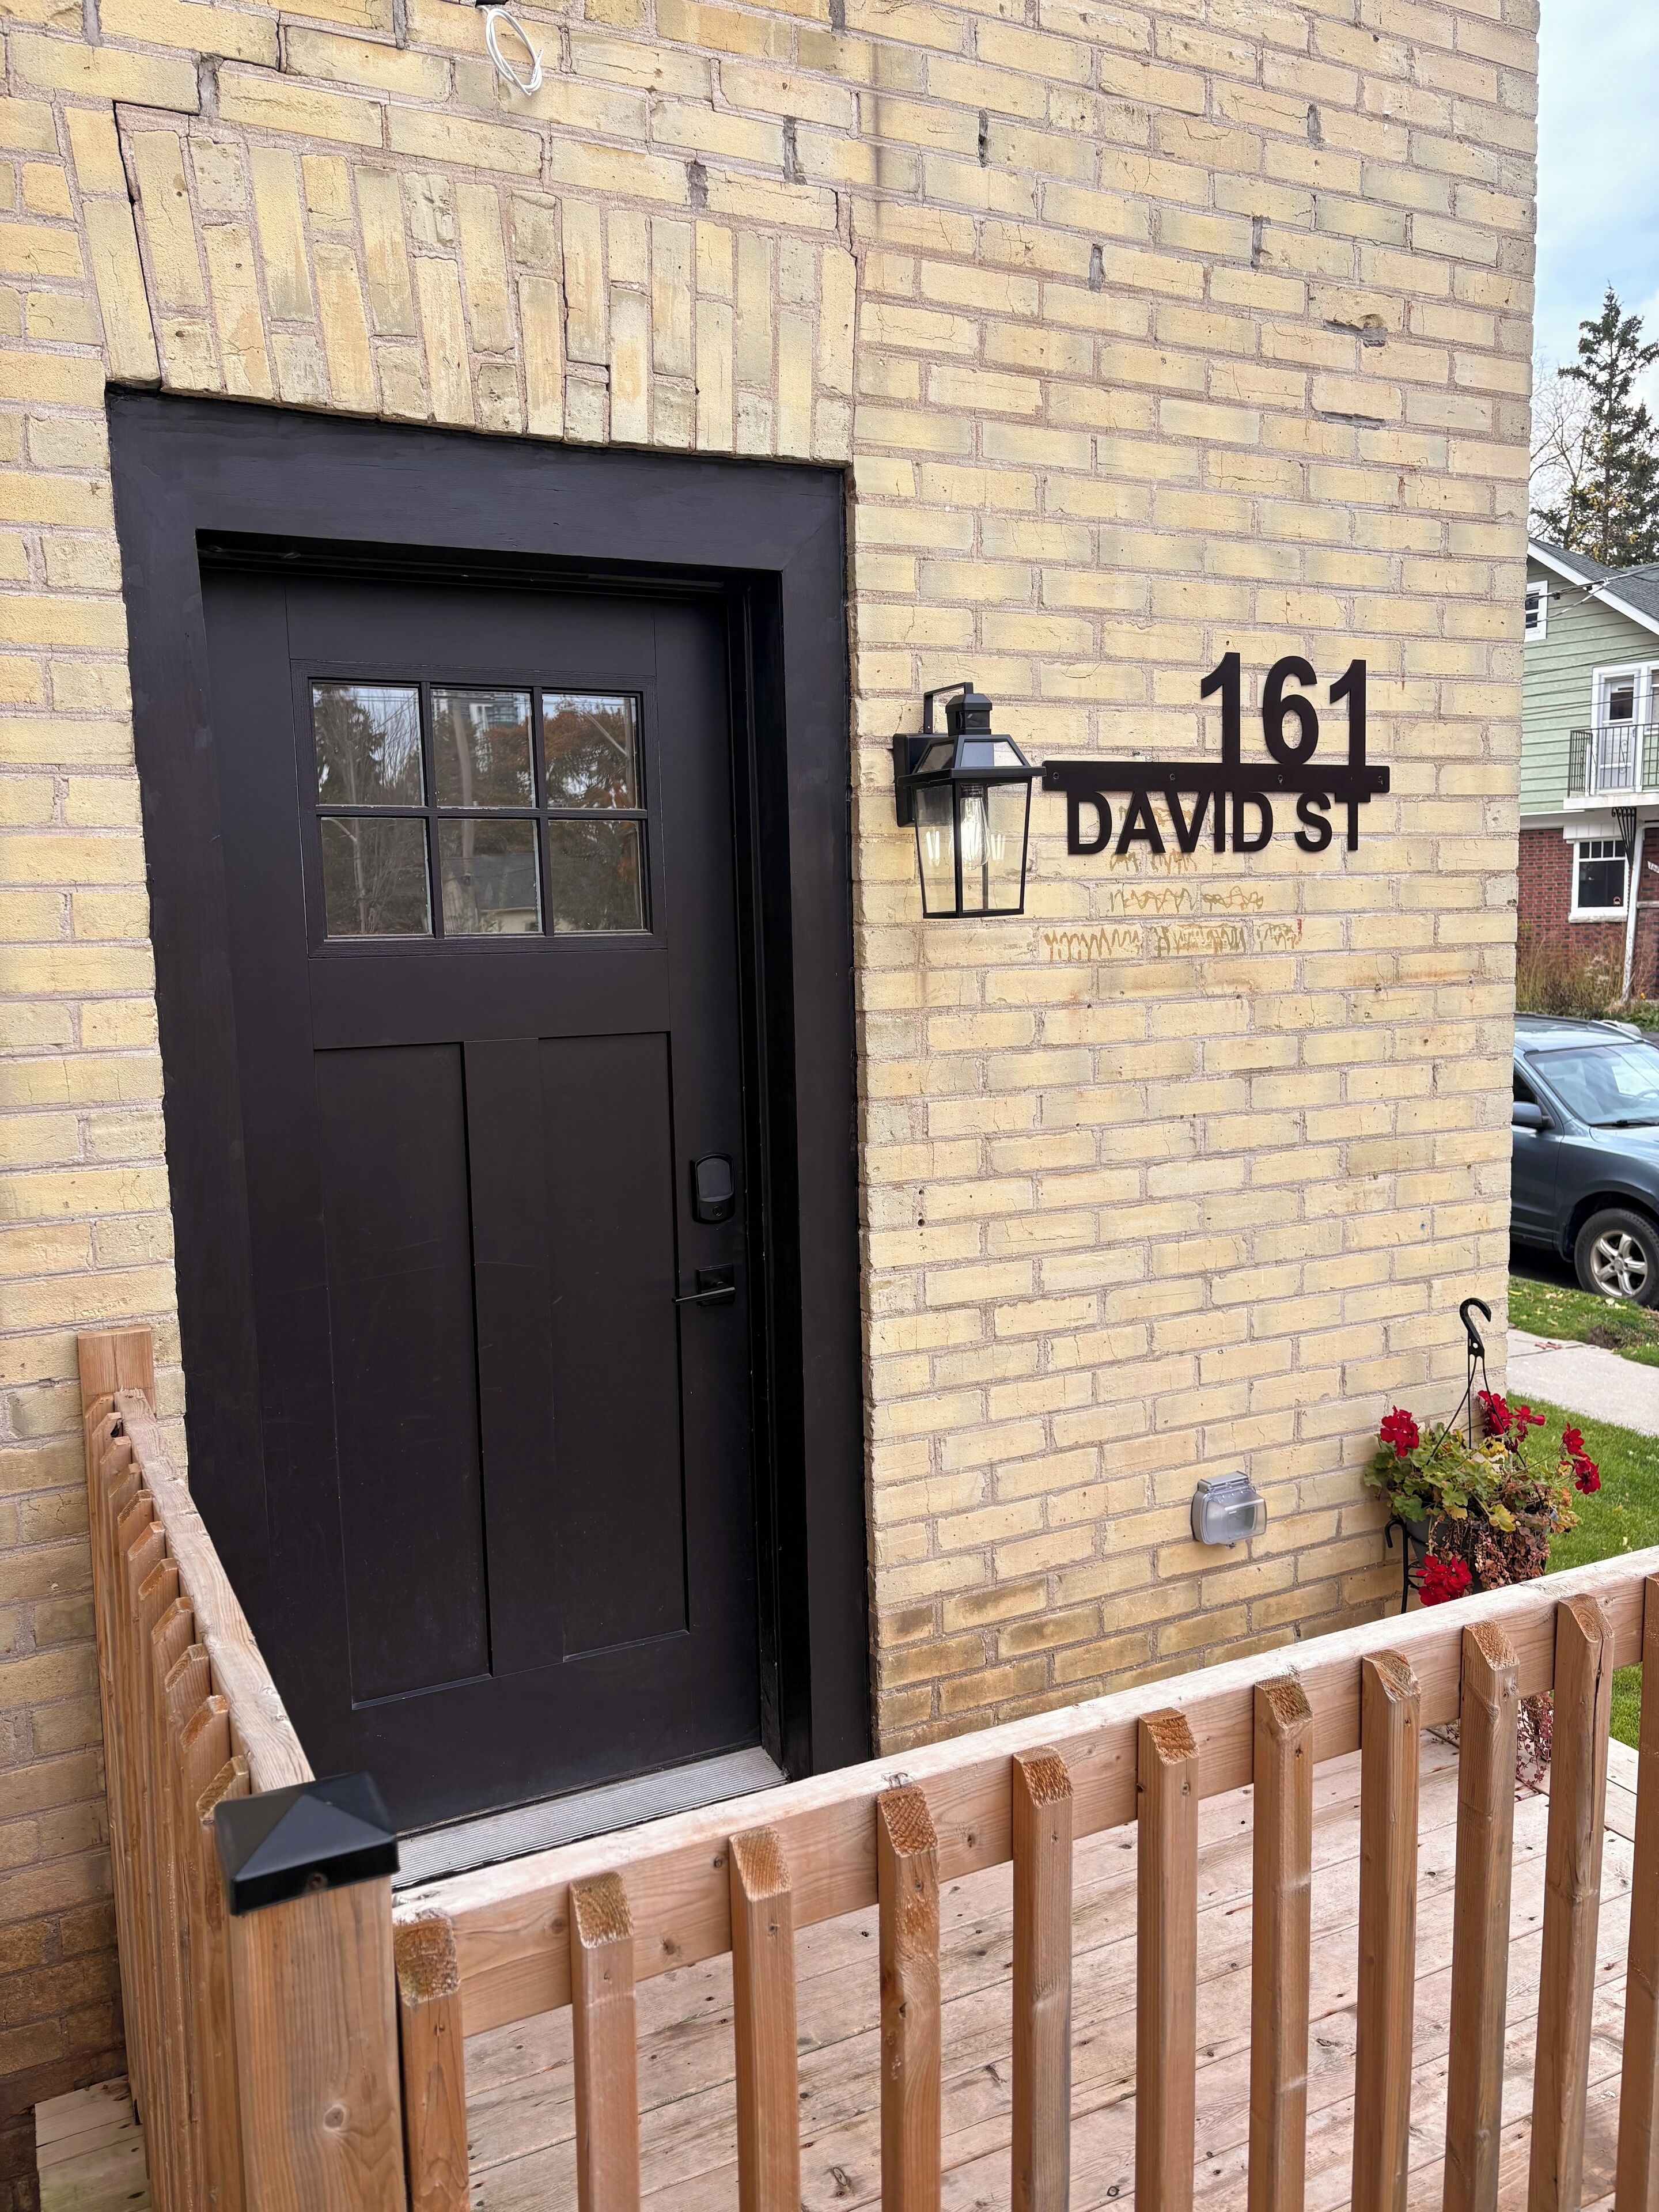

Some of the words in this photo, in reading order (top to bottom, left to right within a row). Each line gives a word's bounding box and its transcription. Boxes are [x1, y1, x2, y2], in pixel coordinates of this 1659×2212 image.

[1201, 652, 1366, 765] 161
[1067, 790, 1273, 855] DAVID
[1294, 791, 1371, 852] ST
